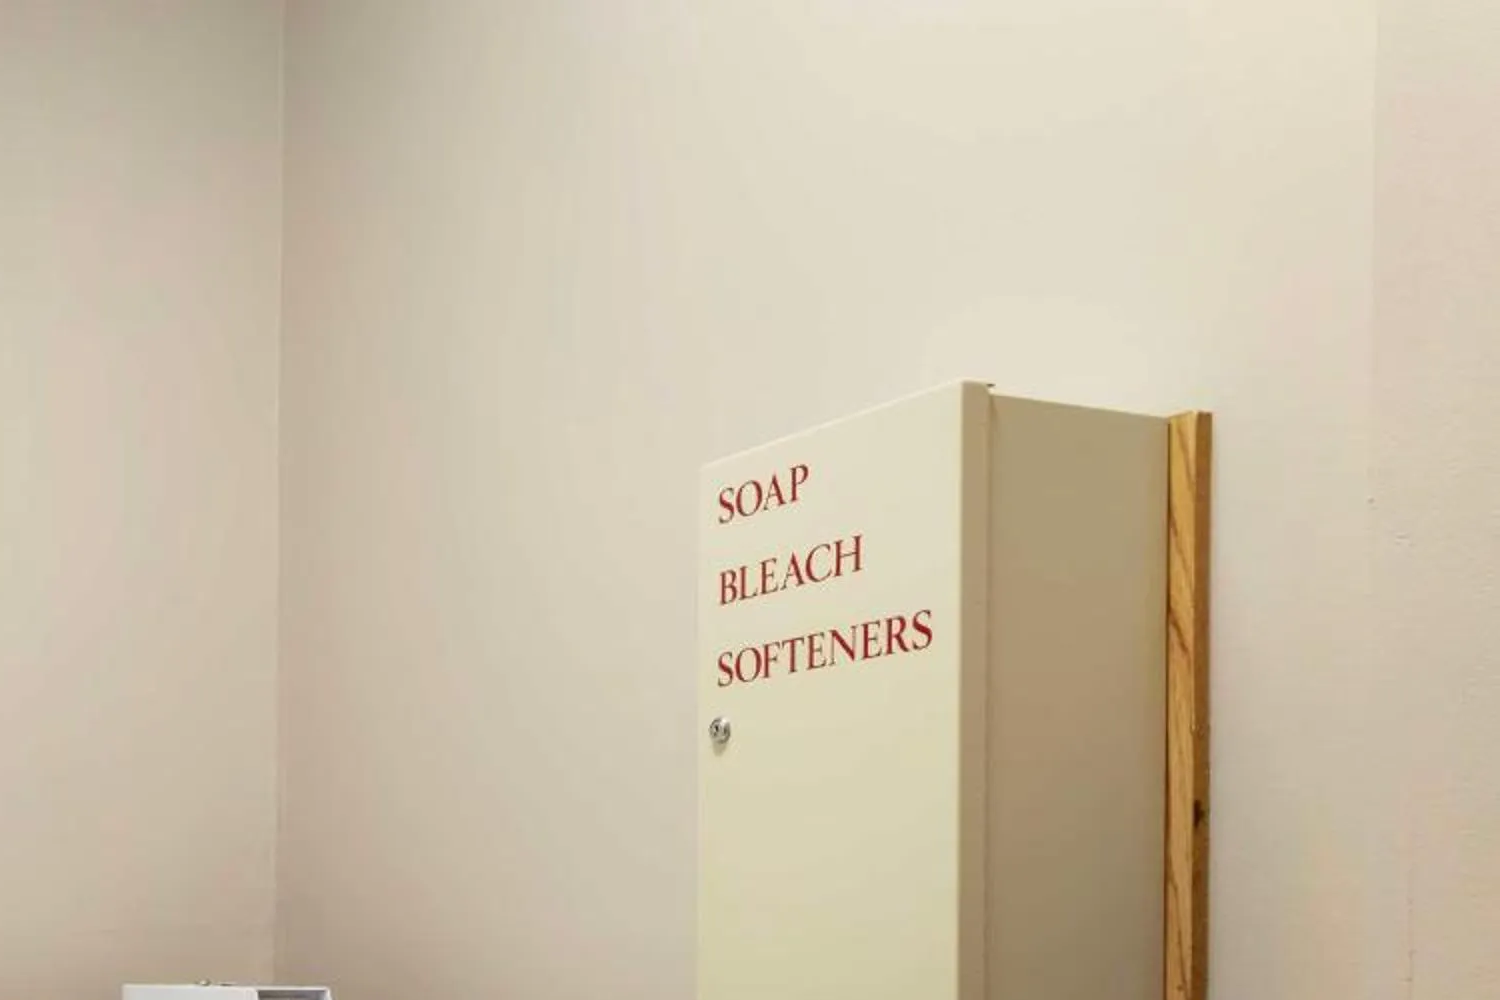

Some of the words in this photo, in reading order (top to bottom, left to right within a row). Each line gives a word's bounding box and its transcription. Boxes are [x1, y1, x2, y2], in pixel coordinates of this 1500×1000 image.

[718, 464, 809, 524] SOAP
[718, 533, 863, 606] BLEACH
[717, 609, 933, 687] SOFTENERS
